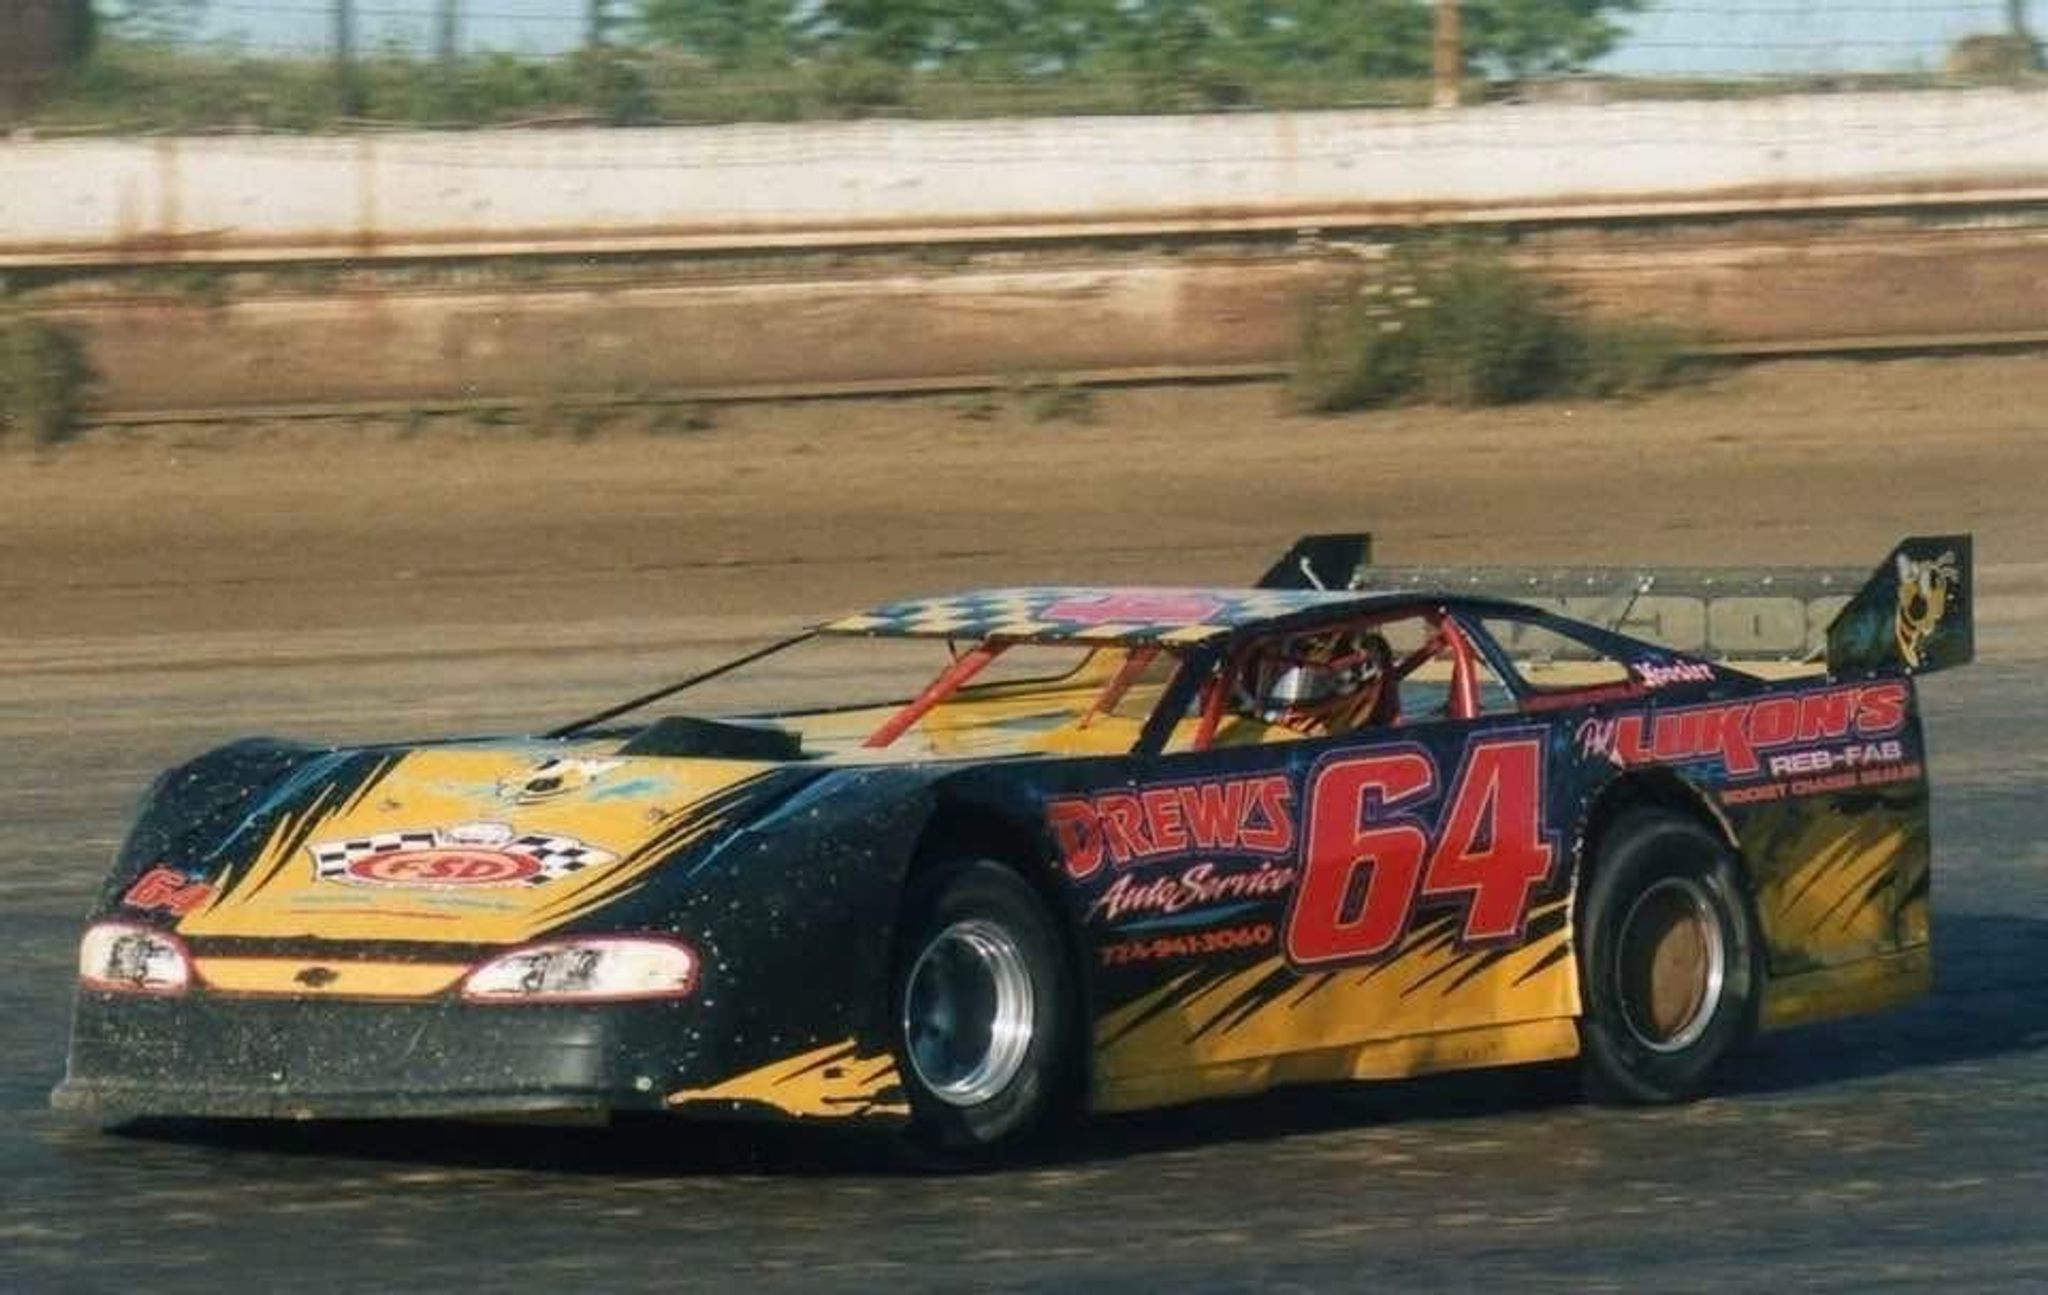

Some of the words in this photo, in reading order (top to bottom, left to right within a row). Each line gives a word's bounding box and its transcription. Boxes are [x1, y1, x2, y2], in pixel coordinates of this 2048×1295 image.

[1613, 684, 1906, 776] LUKON'S
[1769, 740, 1902, 777] REB-FAB
[1286, 738, 1552, 965] 64
[123, 866, 218, 917] 64
